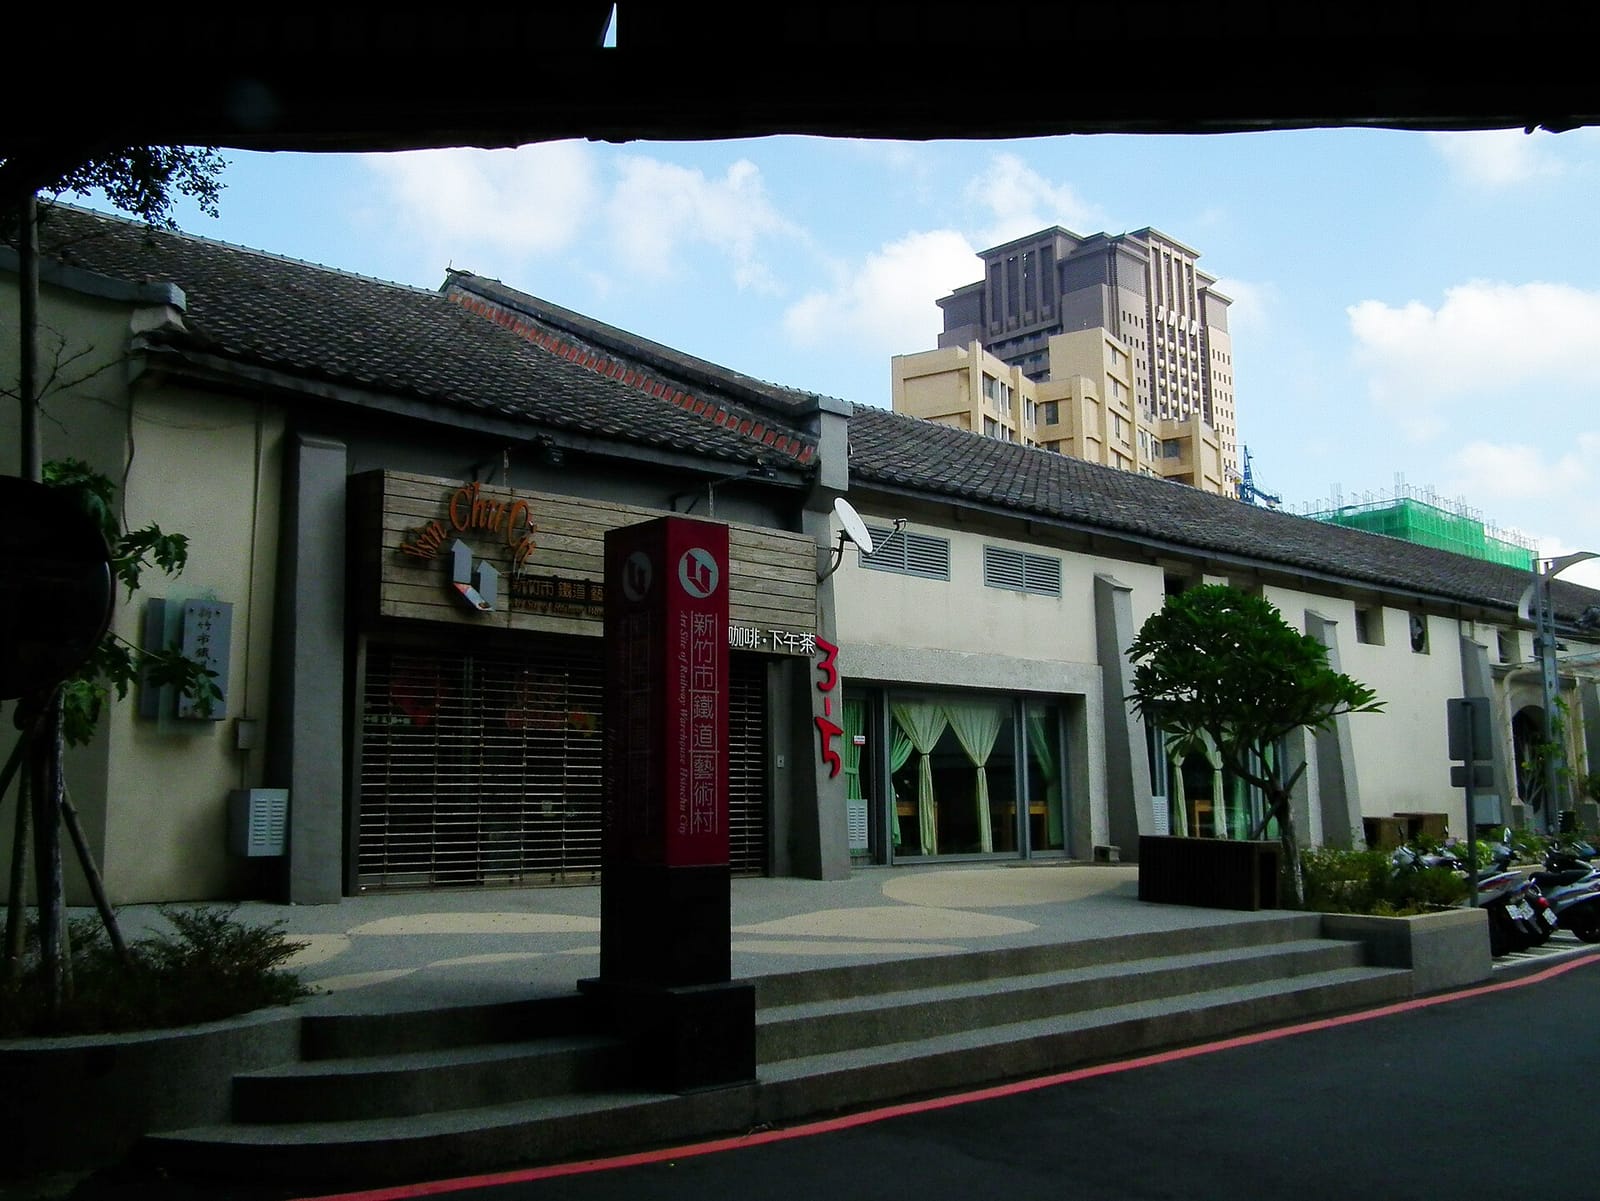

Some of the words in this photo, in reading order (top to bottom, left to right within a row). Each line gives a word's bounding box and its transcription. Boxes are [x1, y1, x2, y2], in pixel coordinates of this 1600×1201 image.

[679, 610, 690, 628] Art
[679, 629, 690, 650] Site
[678, 651, 690, 665] of
[677, 665, 689, 706] Railway
[677, 707, 689, 766] Warehouse
